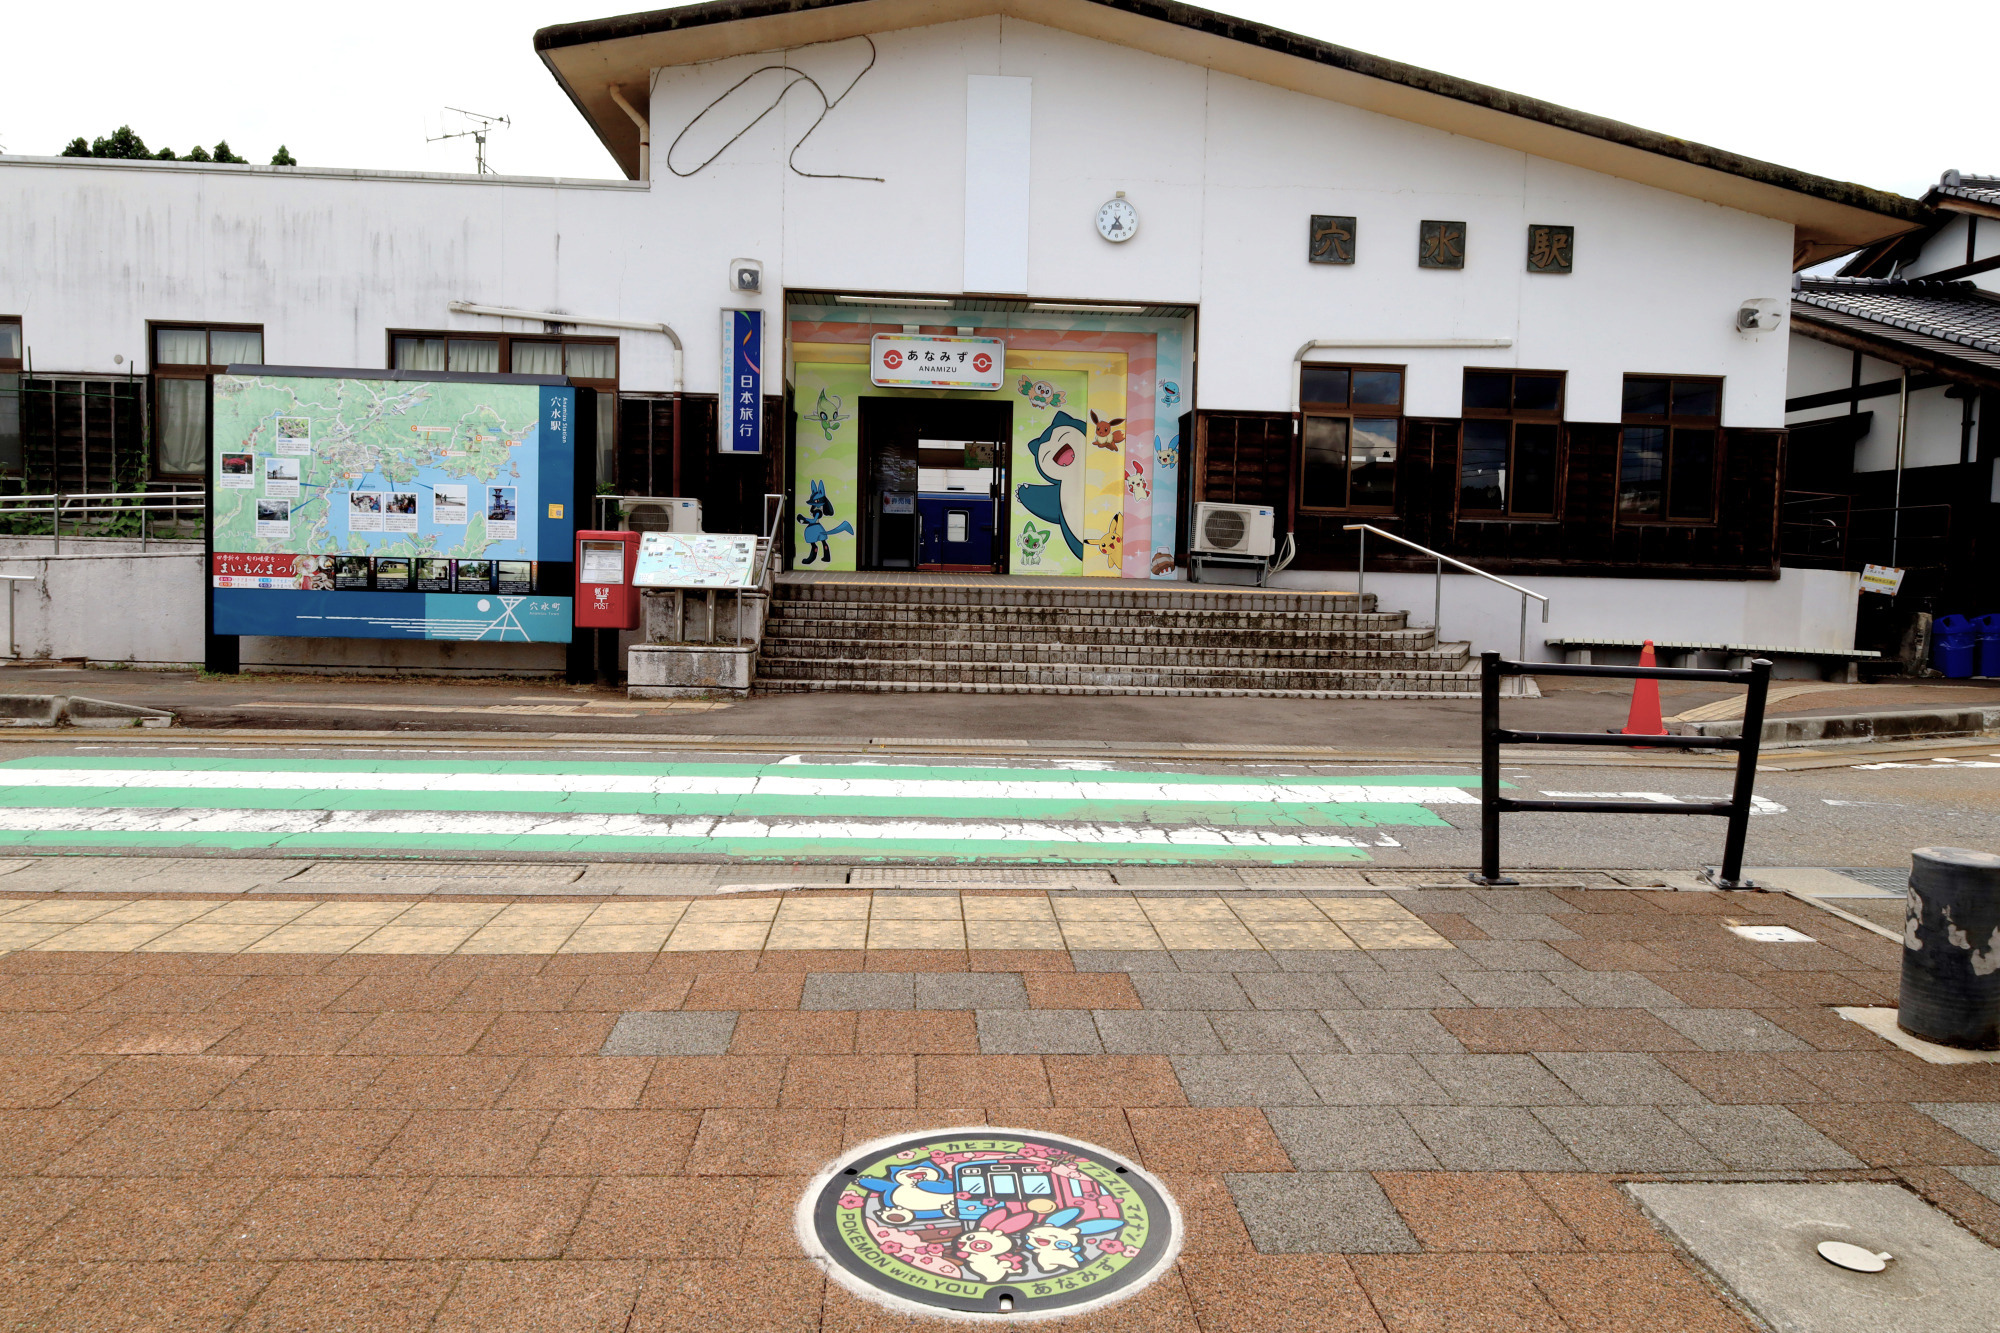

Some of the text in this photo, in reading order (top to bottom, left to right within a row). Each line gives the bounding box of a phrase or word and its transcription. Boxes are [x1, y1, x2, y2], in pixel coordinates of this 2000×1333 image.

[908, 350, 968, 362] あなみず
[550, 396, 561, 431] 穴水駅
[740, 375, 754, 437] 日本旅行
[220, 562, 297, 575] まいもんまつり
[530, 602, 560, 611] 穴水町
[949, 1140, 1015, 1151] カビゴン
[1082, 1162, 1130, 1196] プラスル
[1126, 1204, 1145, 1241] マイナン
[841, 1213, 978, 1295] POKÉMON with YOU
[1032, 1257, 1114, 1295] あなみず
